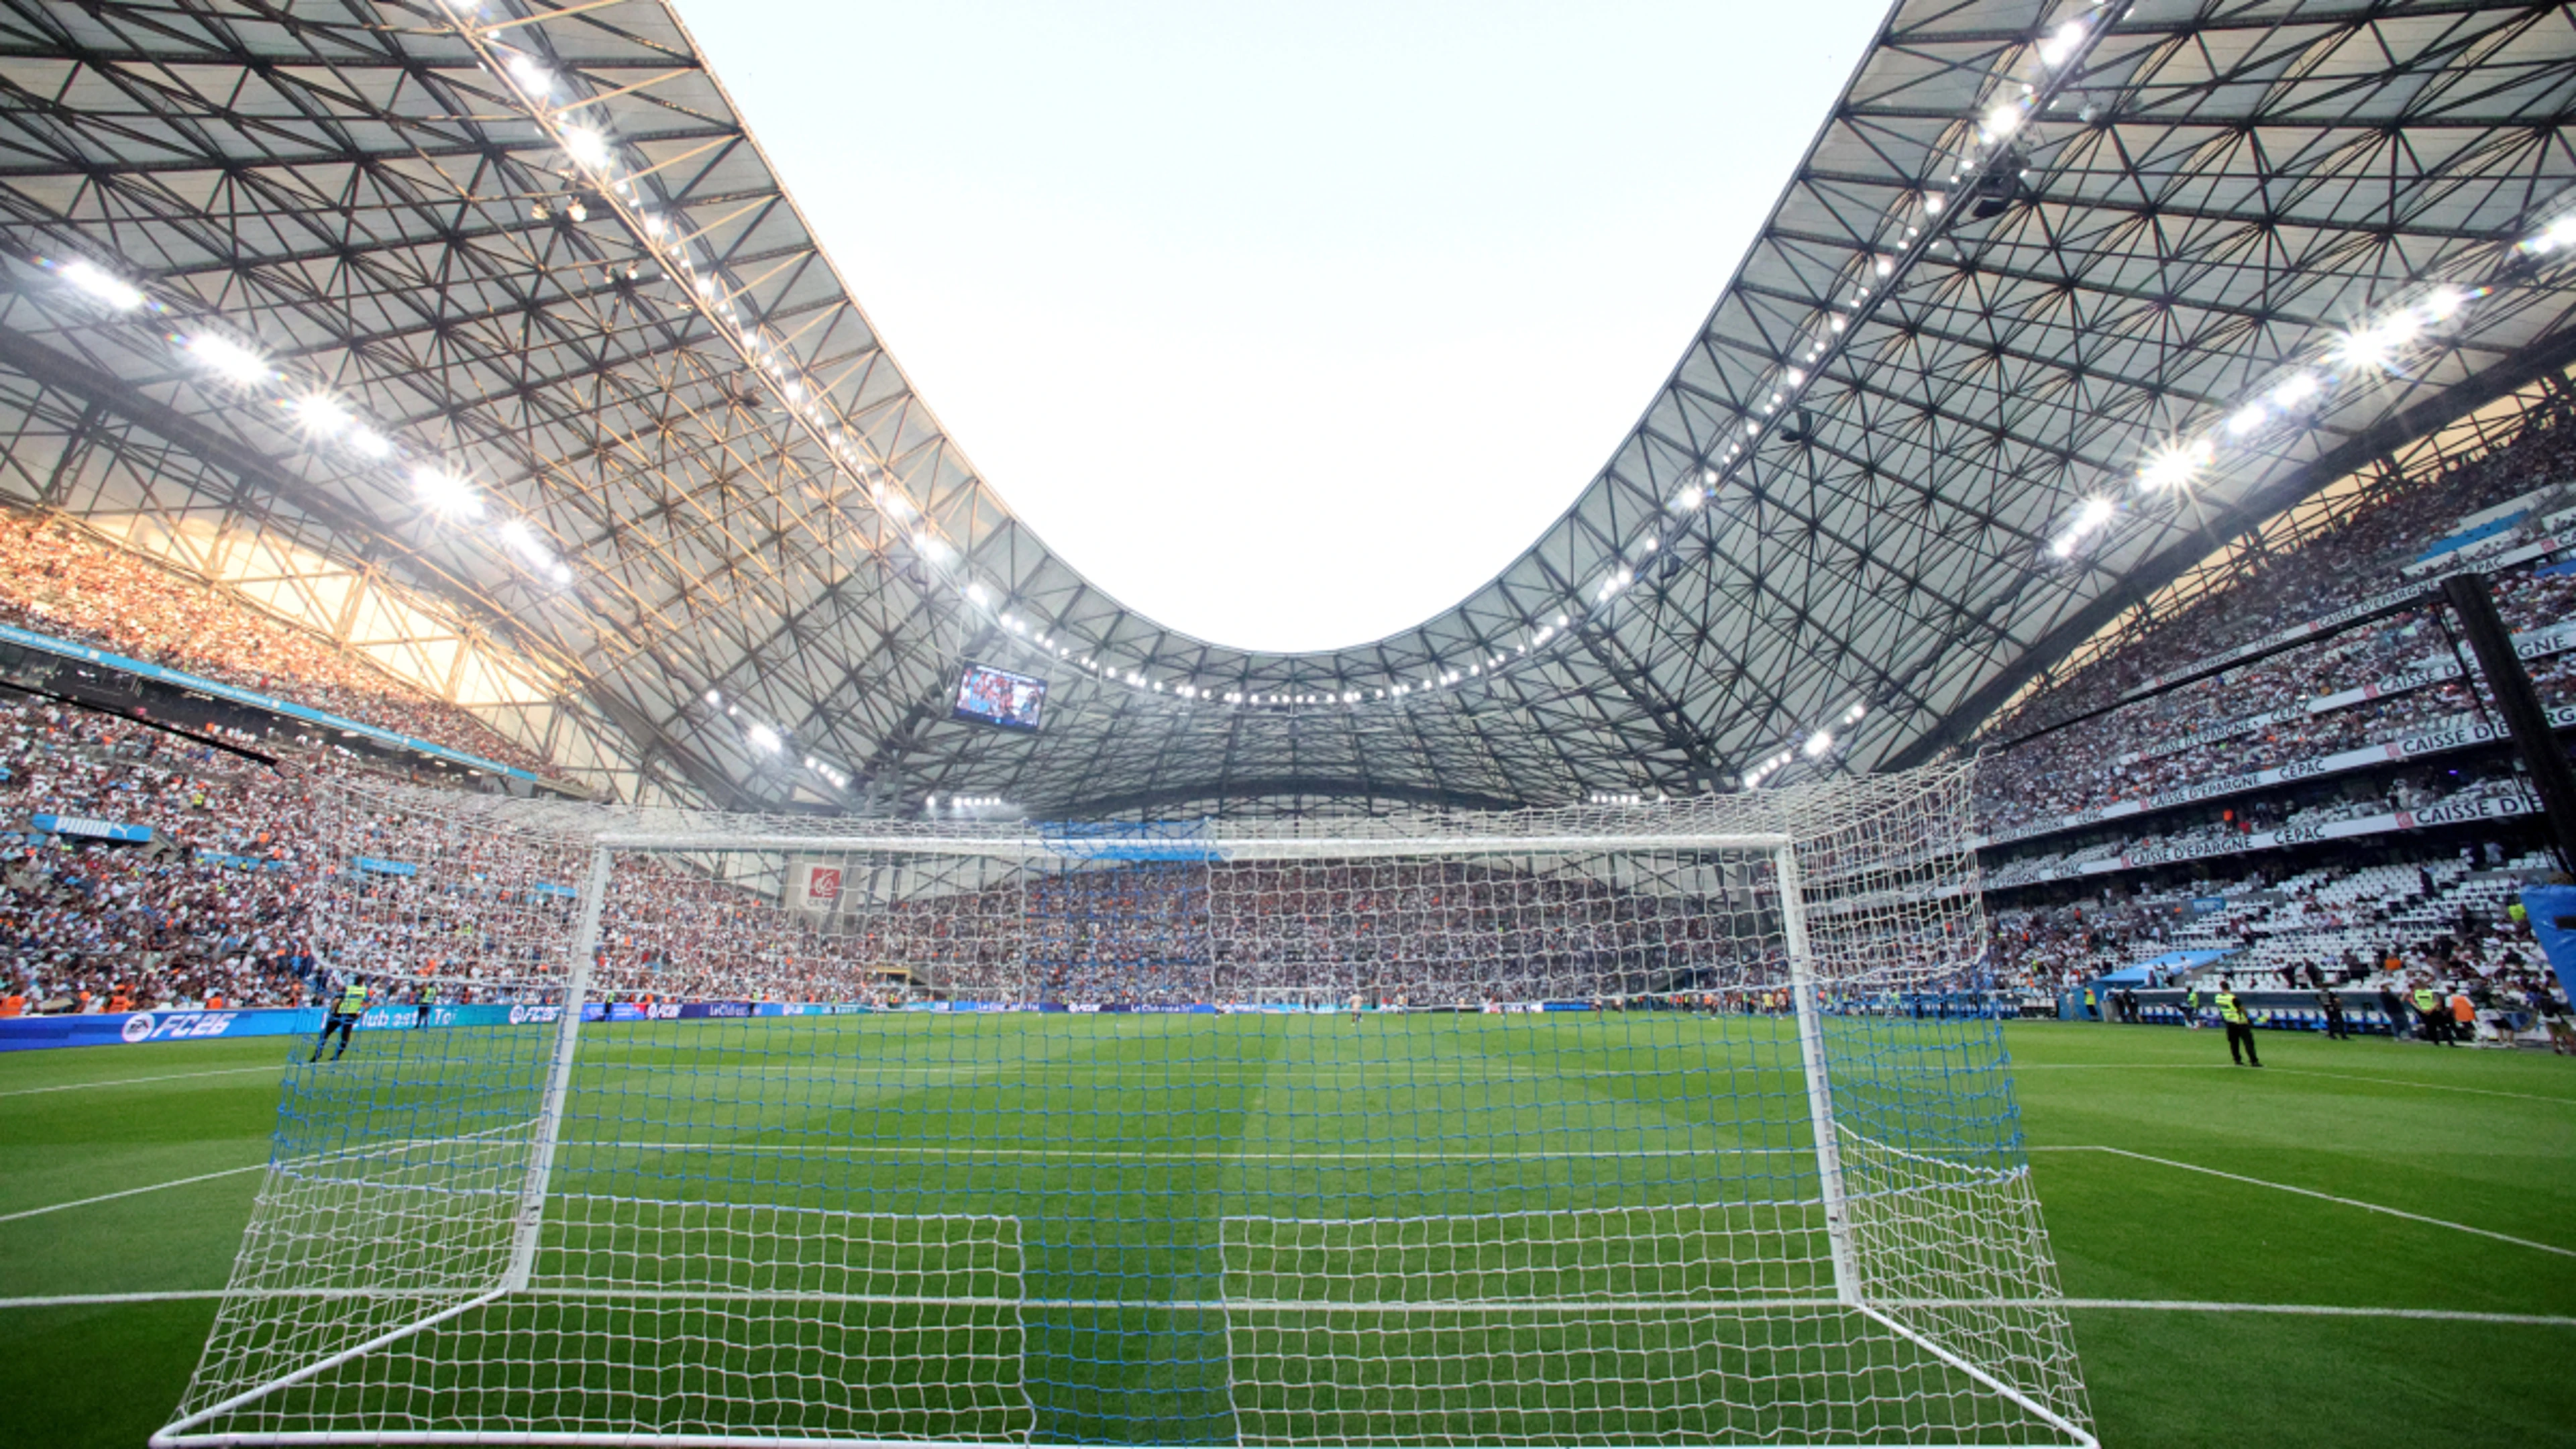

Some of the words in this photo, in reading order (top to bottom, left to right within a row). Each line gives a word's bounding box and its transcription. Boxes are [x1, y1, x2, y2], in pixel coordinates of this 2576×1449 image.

[2320, 606, 2357, 628] CAISSE
[2380, 667, 2434, 692] CAISSE
[2404, 730, 2465, 753] CAISSE
[2279, 759, 2325, 780] CEPAC
[2149, 790, 2186, 807] CAISSE
[2189, 774, 2261, 800] D'EPARGNE
[2416, 800, 2493, 823] CAISSE
[2273, 825, 2325, 845] CEPAC
[2131, 850, 2172, 866] CAISSE
[2174, 837, 2254, 859] D'EPARGNE
